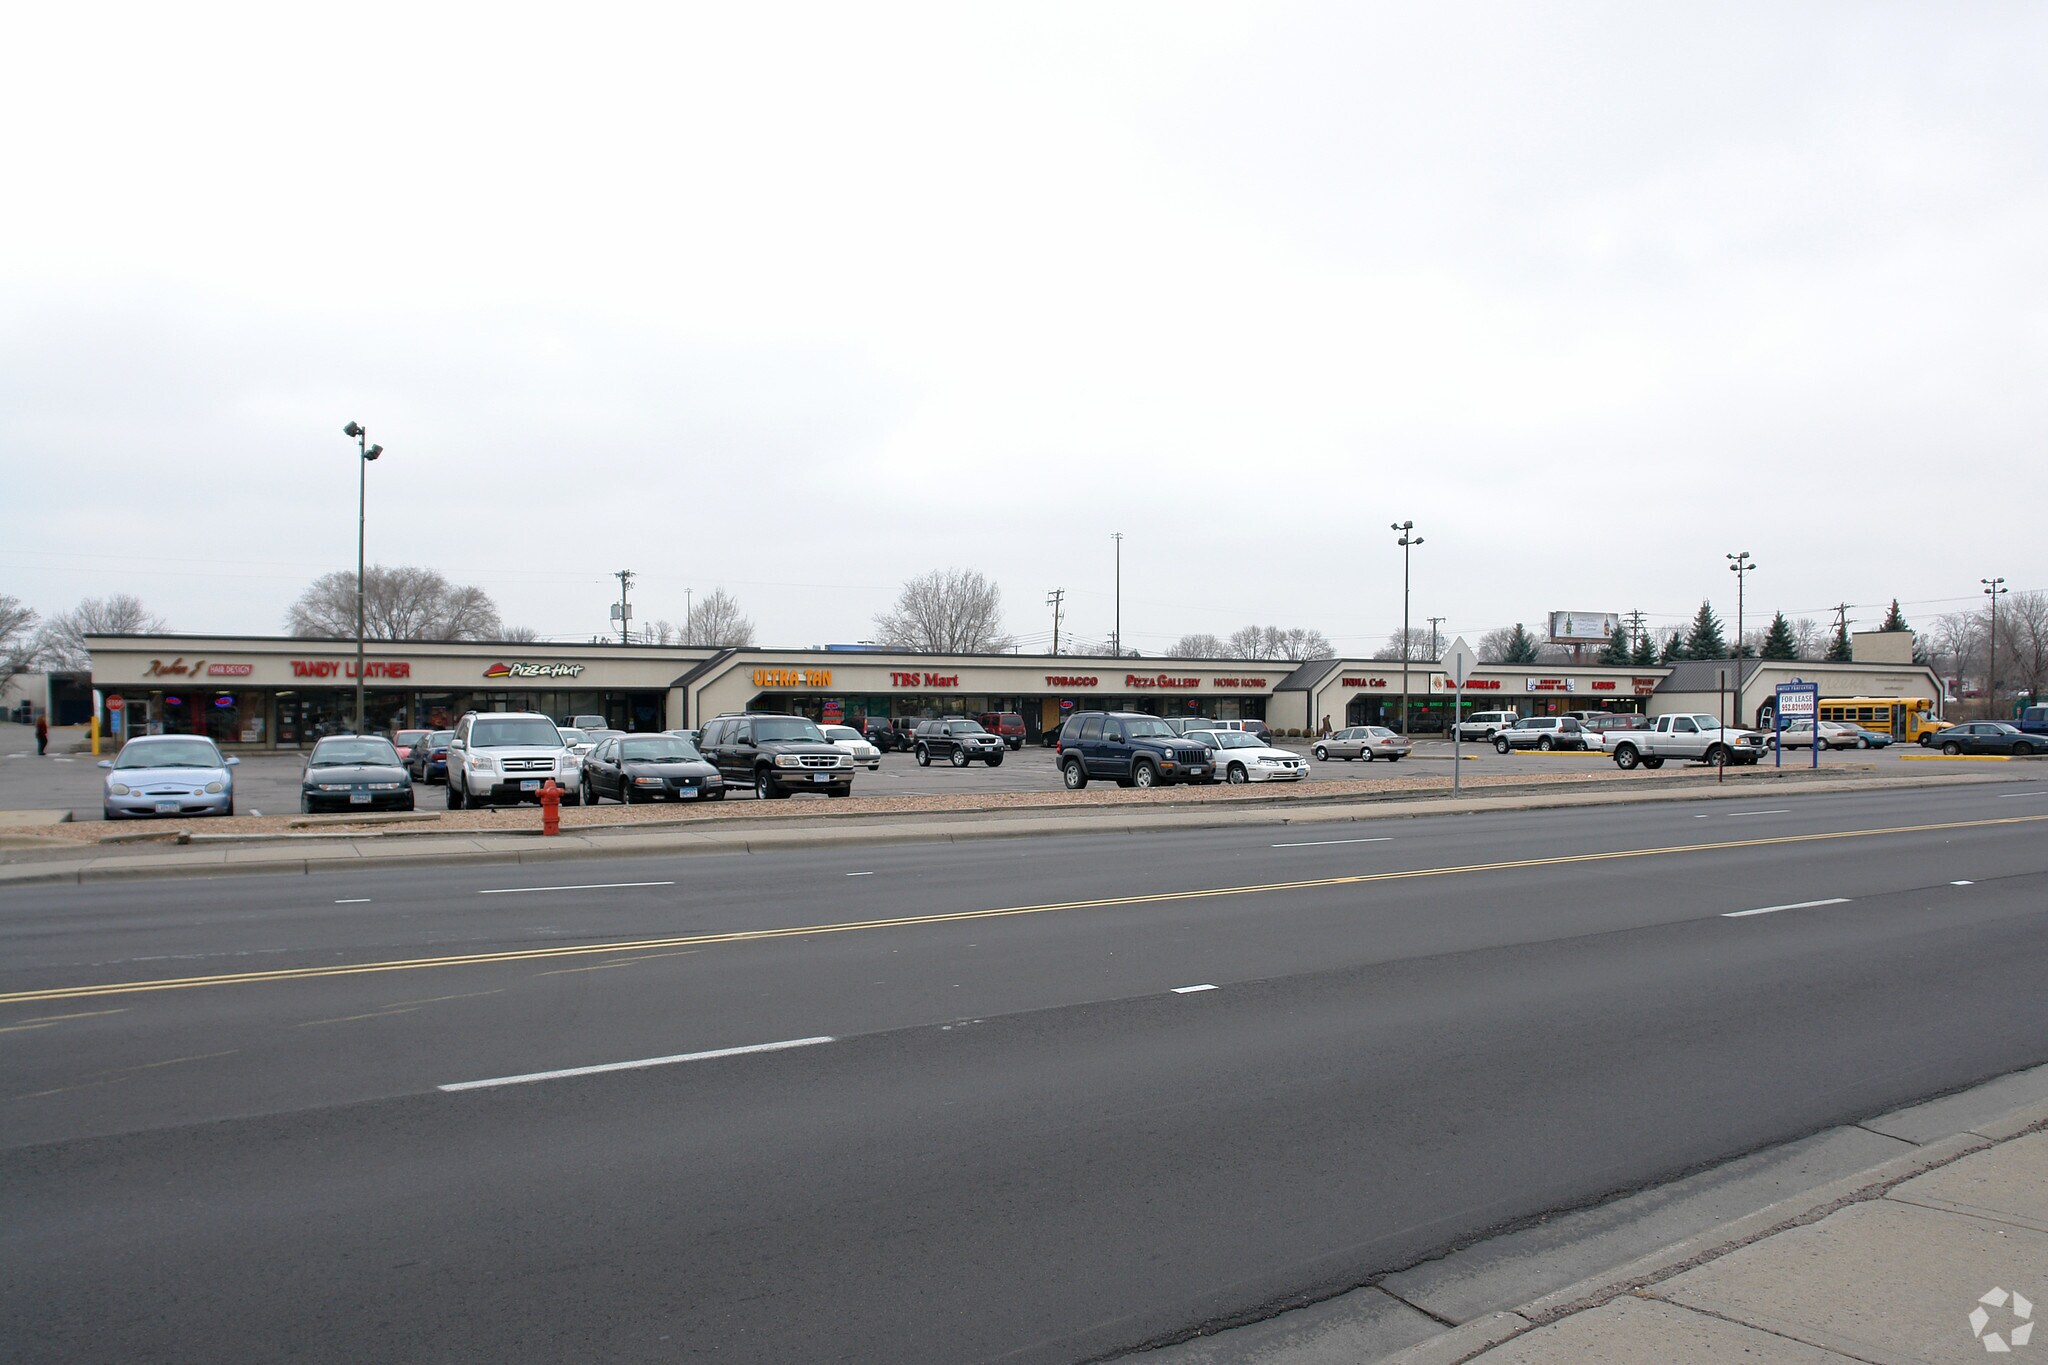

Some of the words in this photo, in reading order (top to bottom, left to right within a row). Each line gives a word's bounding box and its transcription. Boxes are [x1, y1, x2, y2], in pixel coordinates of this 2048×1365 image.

[210, 665, 225, 673] HAIR
[226, 665, 250, 673] DESIGN
[290, 660, 340, 678] TANDY
[507, 662, 551, 678] Pizza
[551, 663, 585, 678] Hut
[753, 669, 800, 687] ULTRA
[804, 669, 833, 687] TAN
[890, 672, 921, 687] TBS
[923, 672, 959, 687] Mart
[1045, 676, 1099, 687] TOBACCO
[1213, 678, 1240, 688] HONG
[1241, 678, 1267, 688] KONG
[1342, 677, 1367, 687] INDIA
[1781, 695, 1793, 703] FOR
